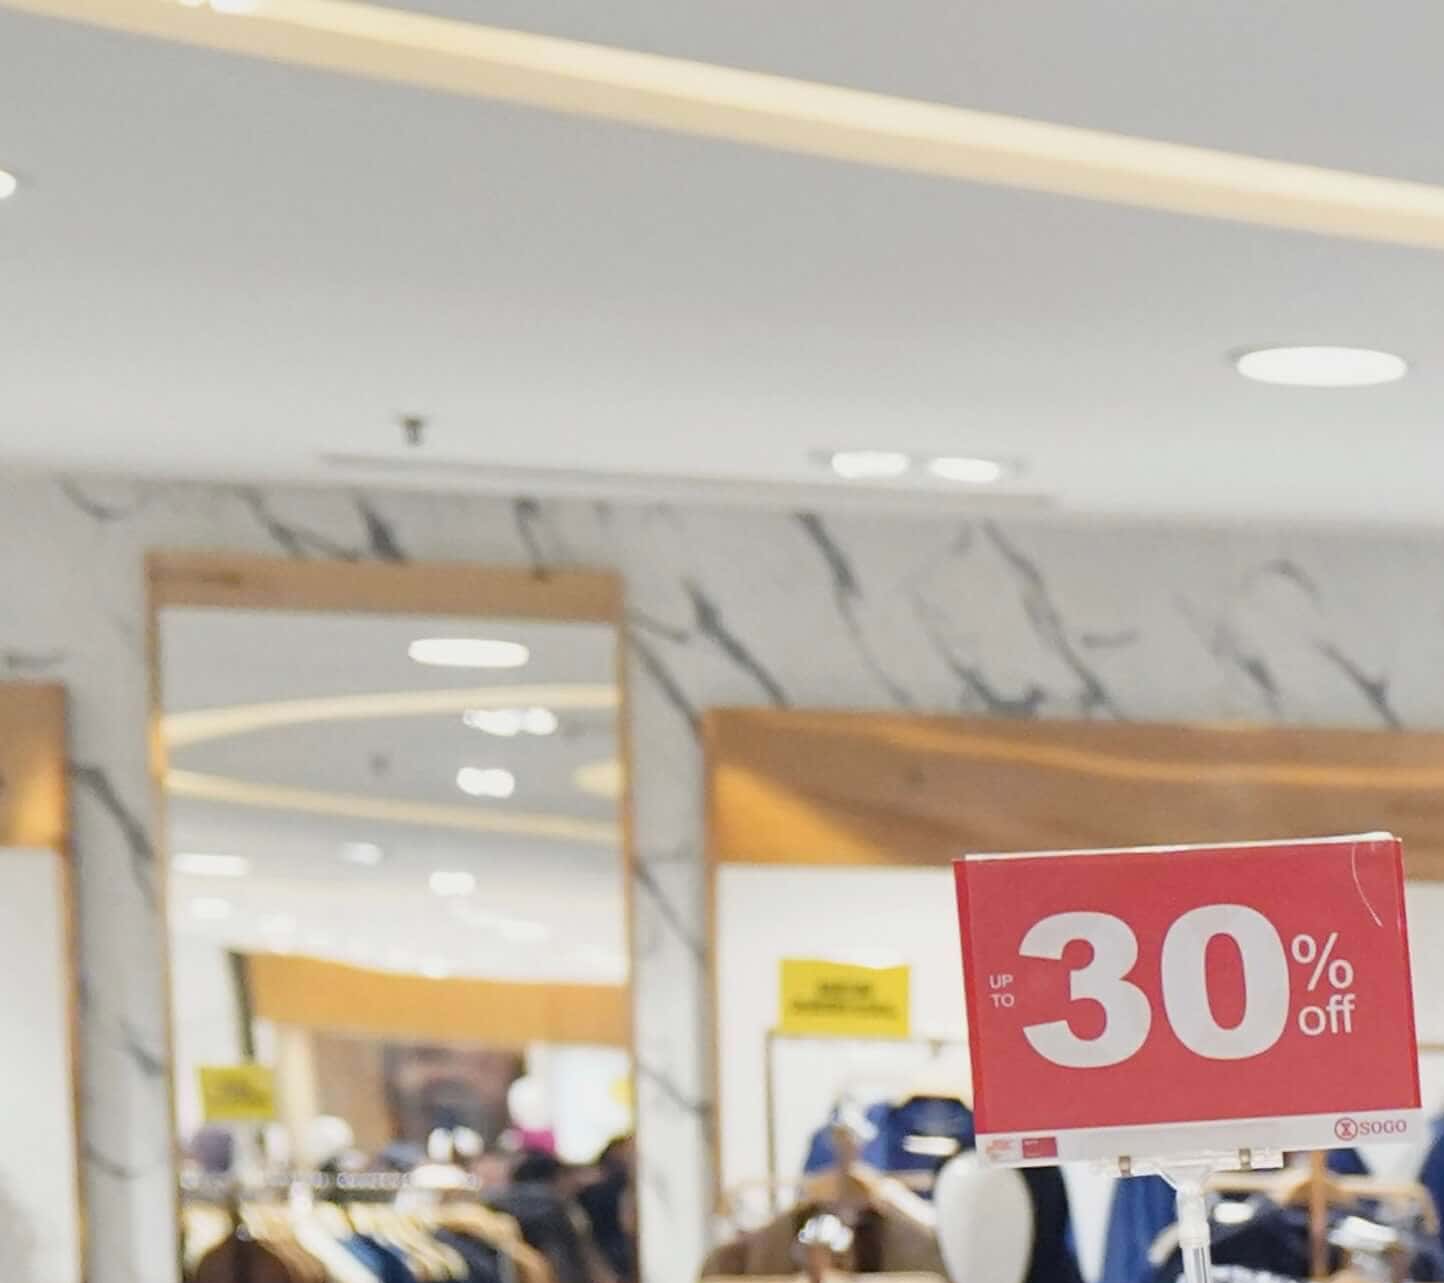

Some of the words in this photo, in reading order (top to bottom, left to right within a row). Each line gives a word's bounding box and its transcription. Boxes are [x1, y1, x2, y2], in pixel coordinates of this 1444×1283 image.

[989, 973, 1014, 990] UP
[991, 993, 1015, 1009] TO
[1297, 993, 1356, 1037] off
[1359, 1119, 1408, 1136] SOGO
